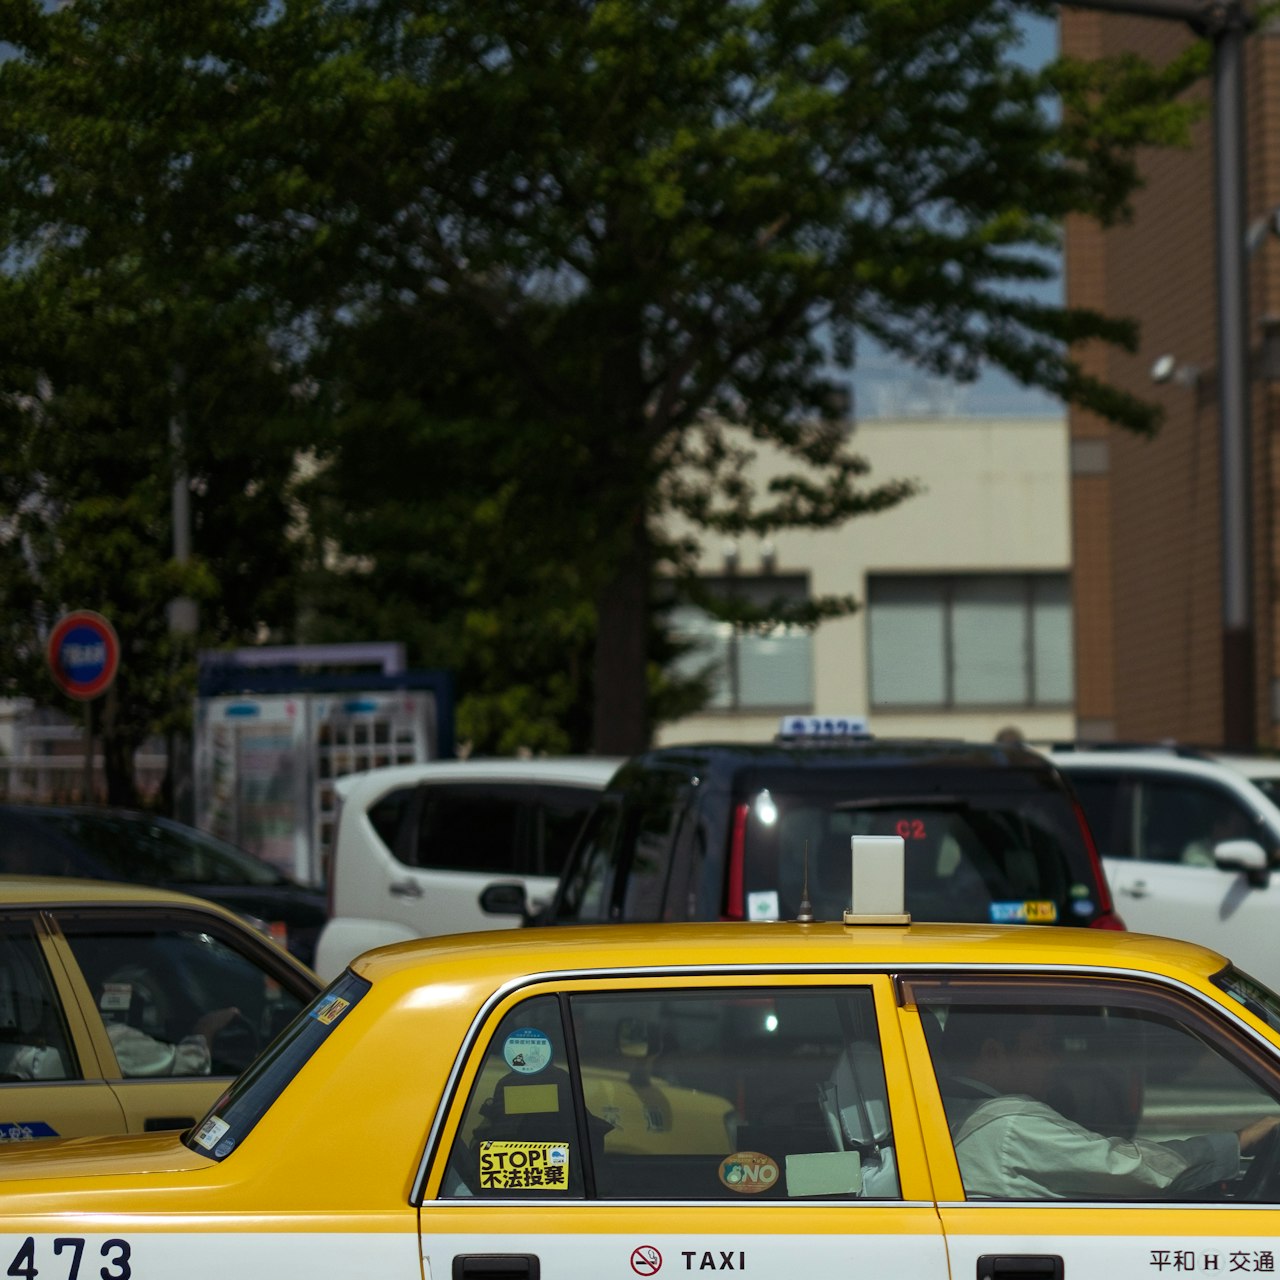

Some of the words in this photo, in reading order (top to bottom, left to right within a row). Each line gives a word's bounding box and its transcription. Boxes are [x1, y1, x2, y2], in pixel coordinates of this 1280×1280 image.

[481, 1150, 548, 1170] STOP!
[481, 1166, 565, 1188] 不法投棄
[681, 1251, 747, 1270] TAXI
[1150, 1250, 1195, 1272] 平和
[1229, 1250, 1275, 1272] 交通
